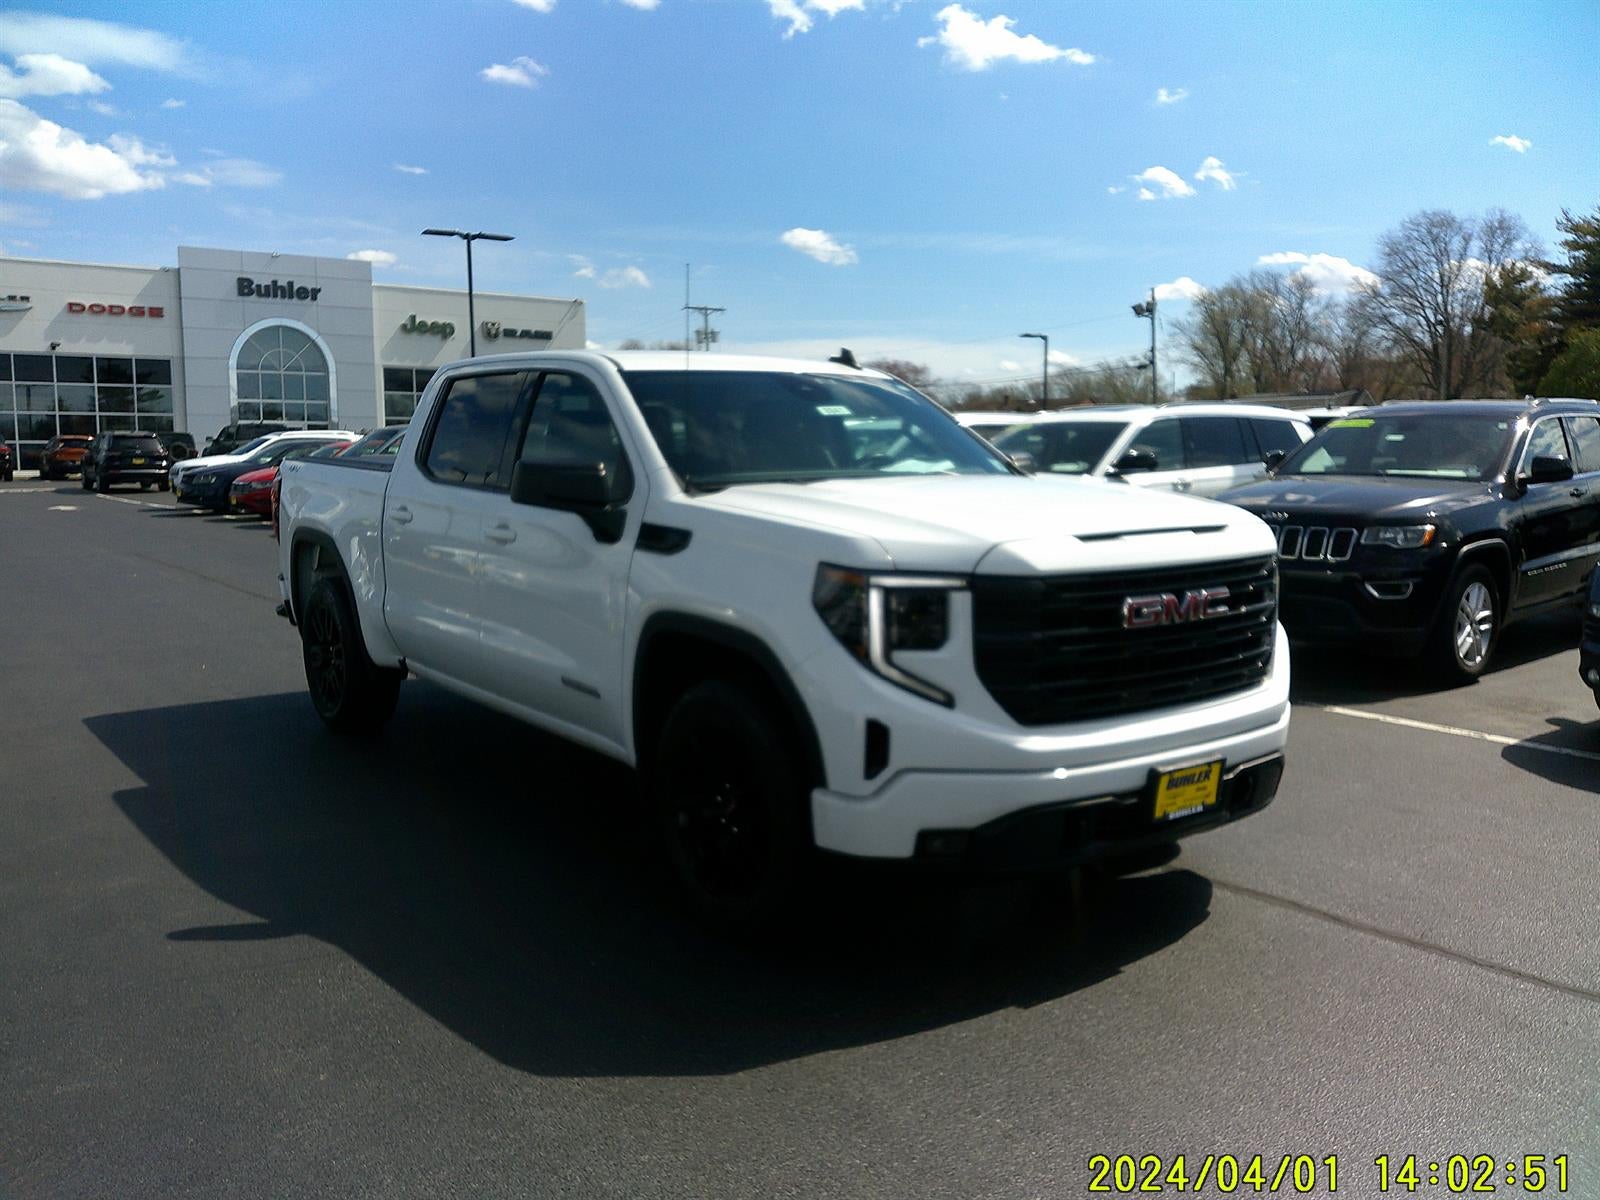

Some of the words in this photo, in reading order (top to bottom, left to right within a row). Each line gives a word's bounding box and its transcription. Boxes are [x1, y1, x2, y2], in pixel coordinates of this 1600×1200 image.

[236, 276, 321, 302] Buhler
[66, 301, 165, 319] DODGE
[402, 313, 456, 341] Jeep
[1122, 586, 1231, 629] GMC
